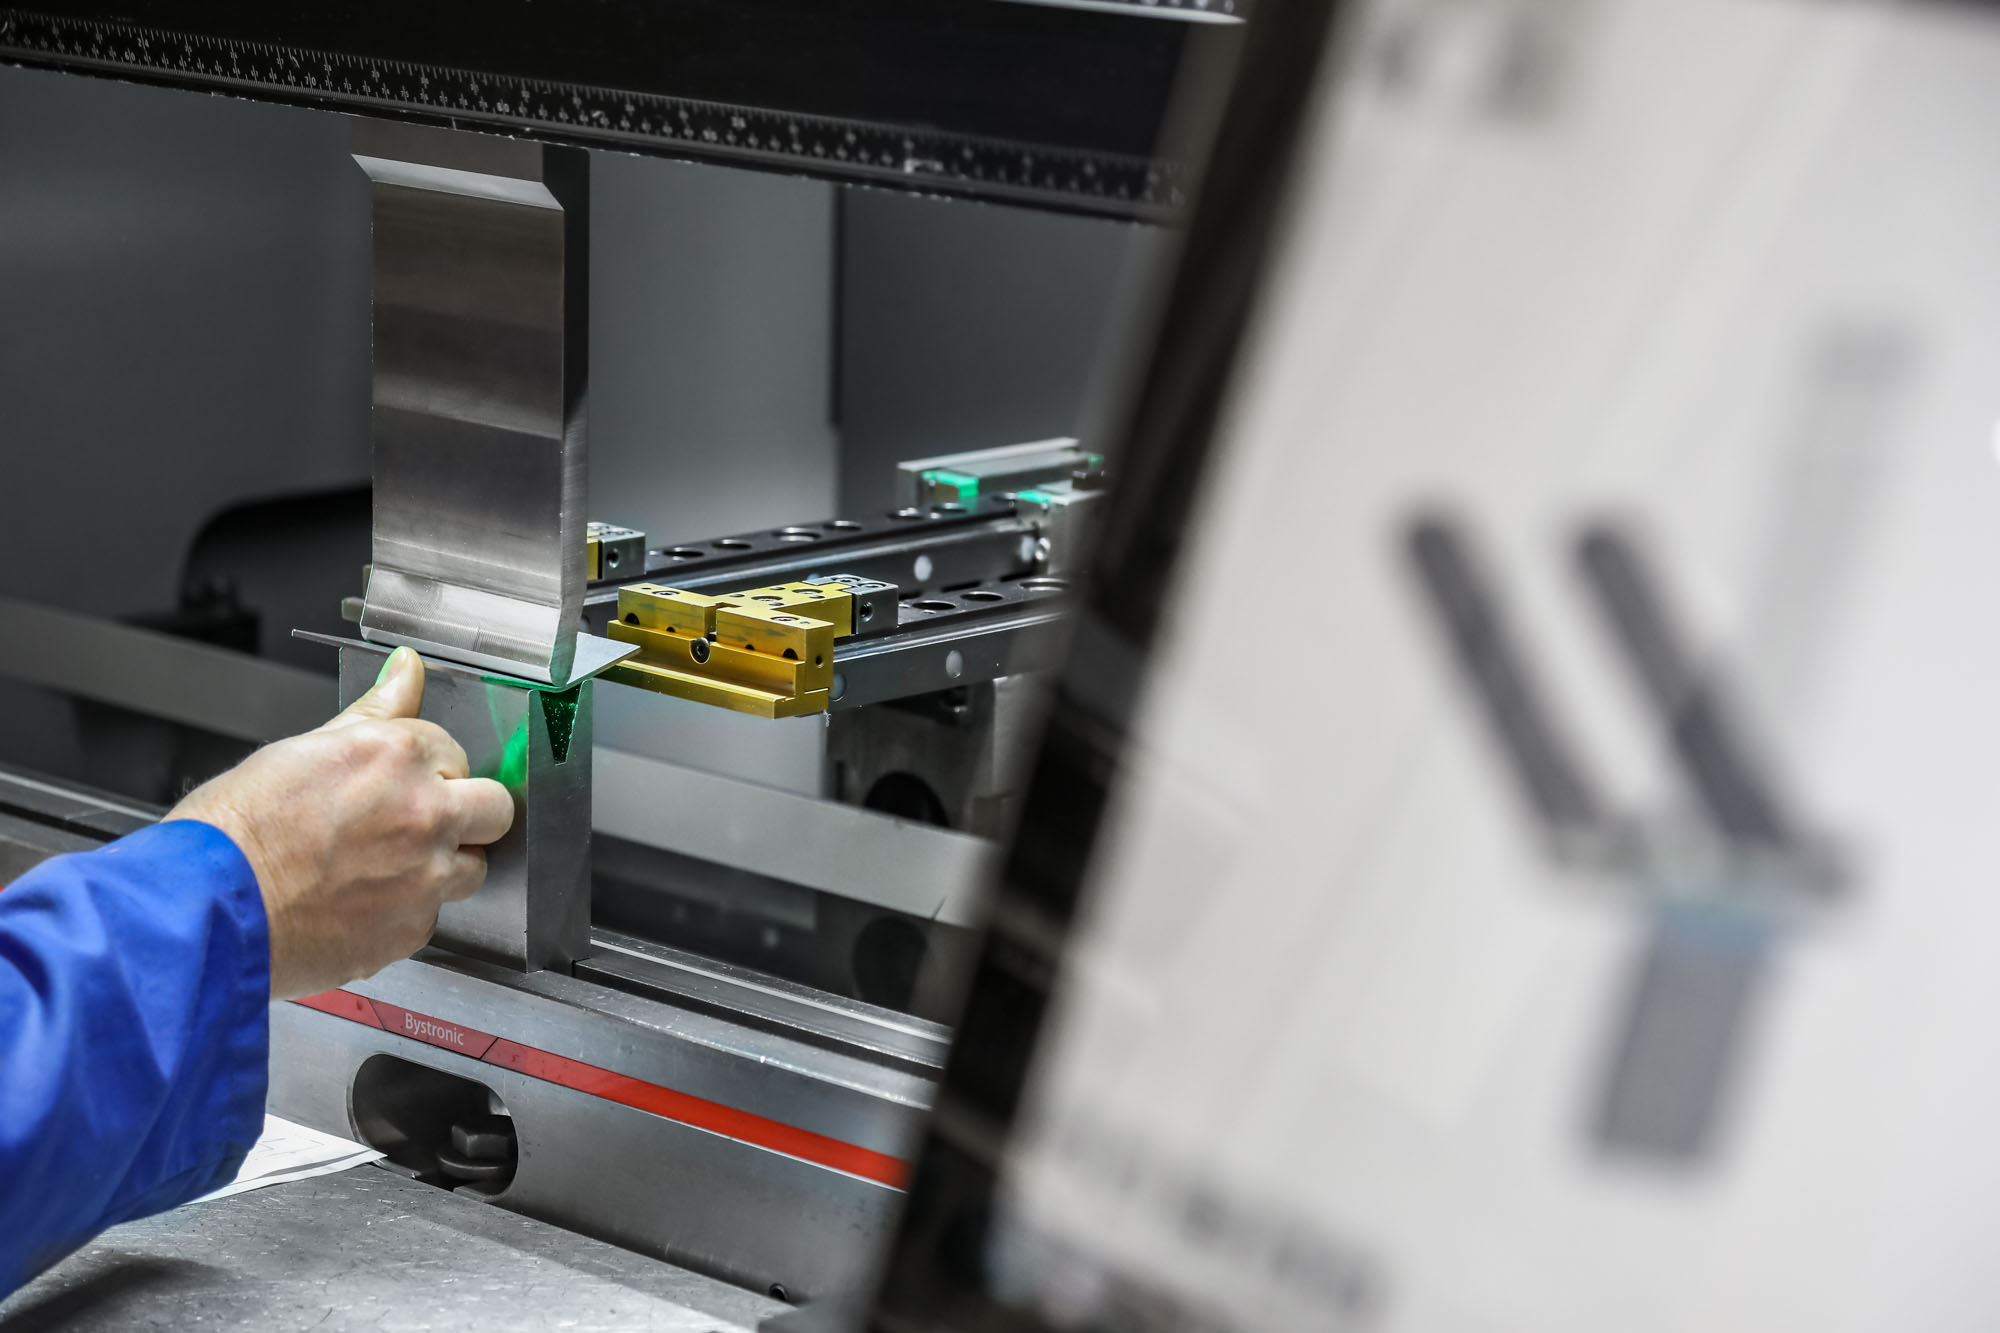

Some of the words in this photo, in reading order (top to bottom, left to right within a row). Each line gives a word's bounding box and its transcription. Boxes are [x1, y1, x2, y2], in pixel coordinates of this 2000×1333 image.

[136, 37, 150, 48] 24
[304, 75, 317, 87] 70
[405, 1012, 464, 1046] Bystronic
